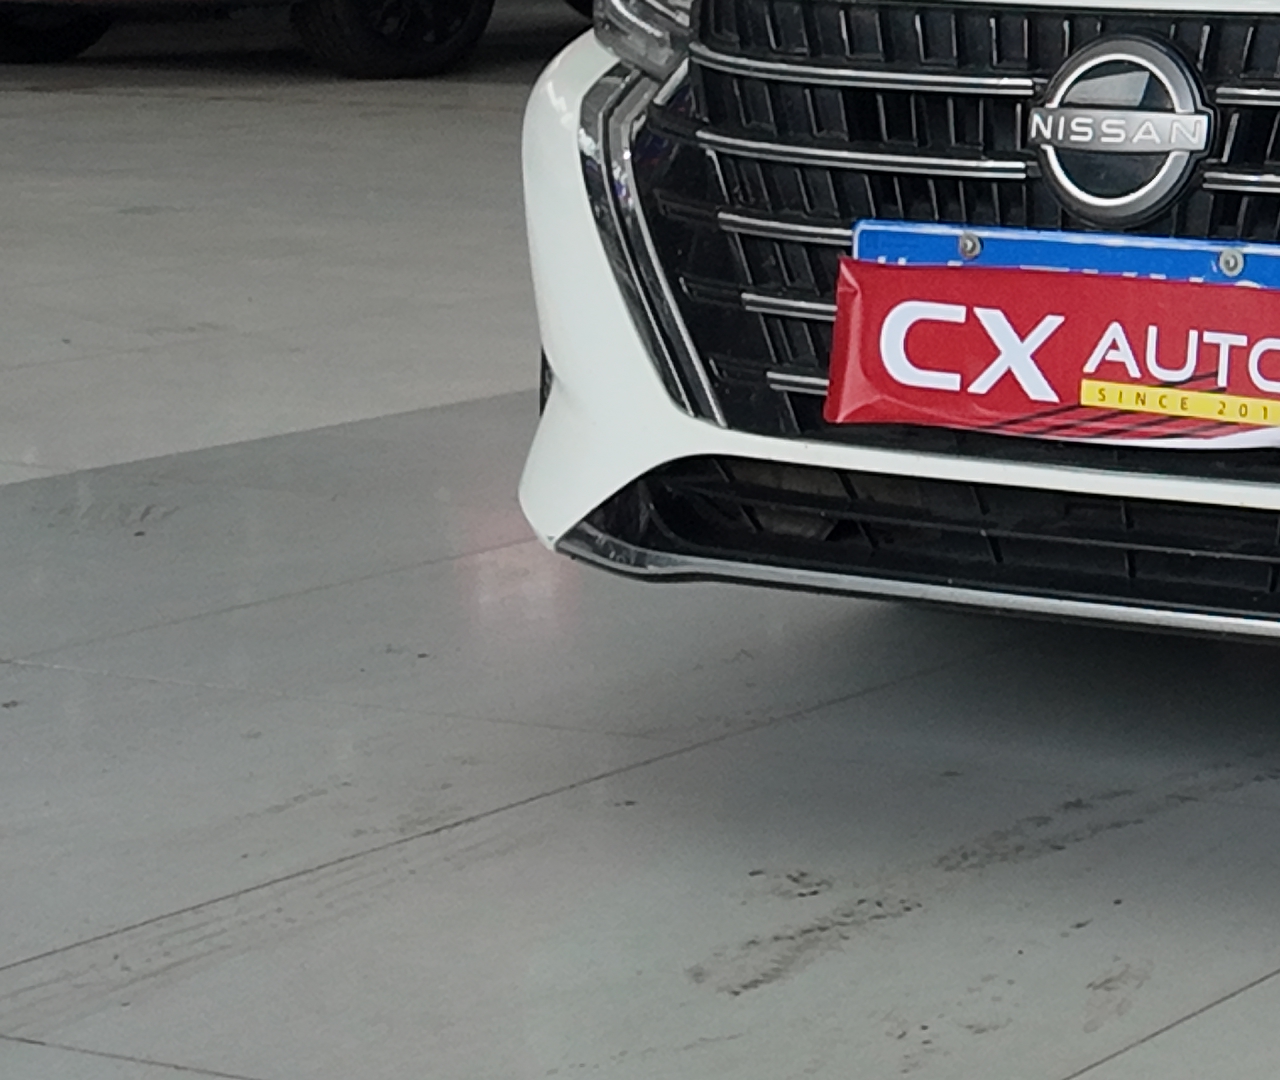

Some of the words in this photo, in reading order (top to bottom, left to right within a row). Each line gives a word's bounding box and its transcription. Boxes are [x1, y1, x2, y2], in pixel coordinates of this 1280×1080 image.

[1030, 112, 1203, 146] NISSAN
[879, 300, 1065, 403] CX
[1097, 388, 1190, 411] SINCE
